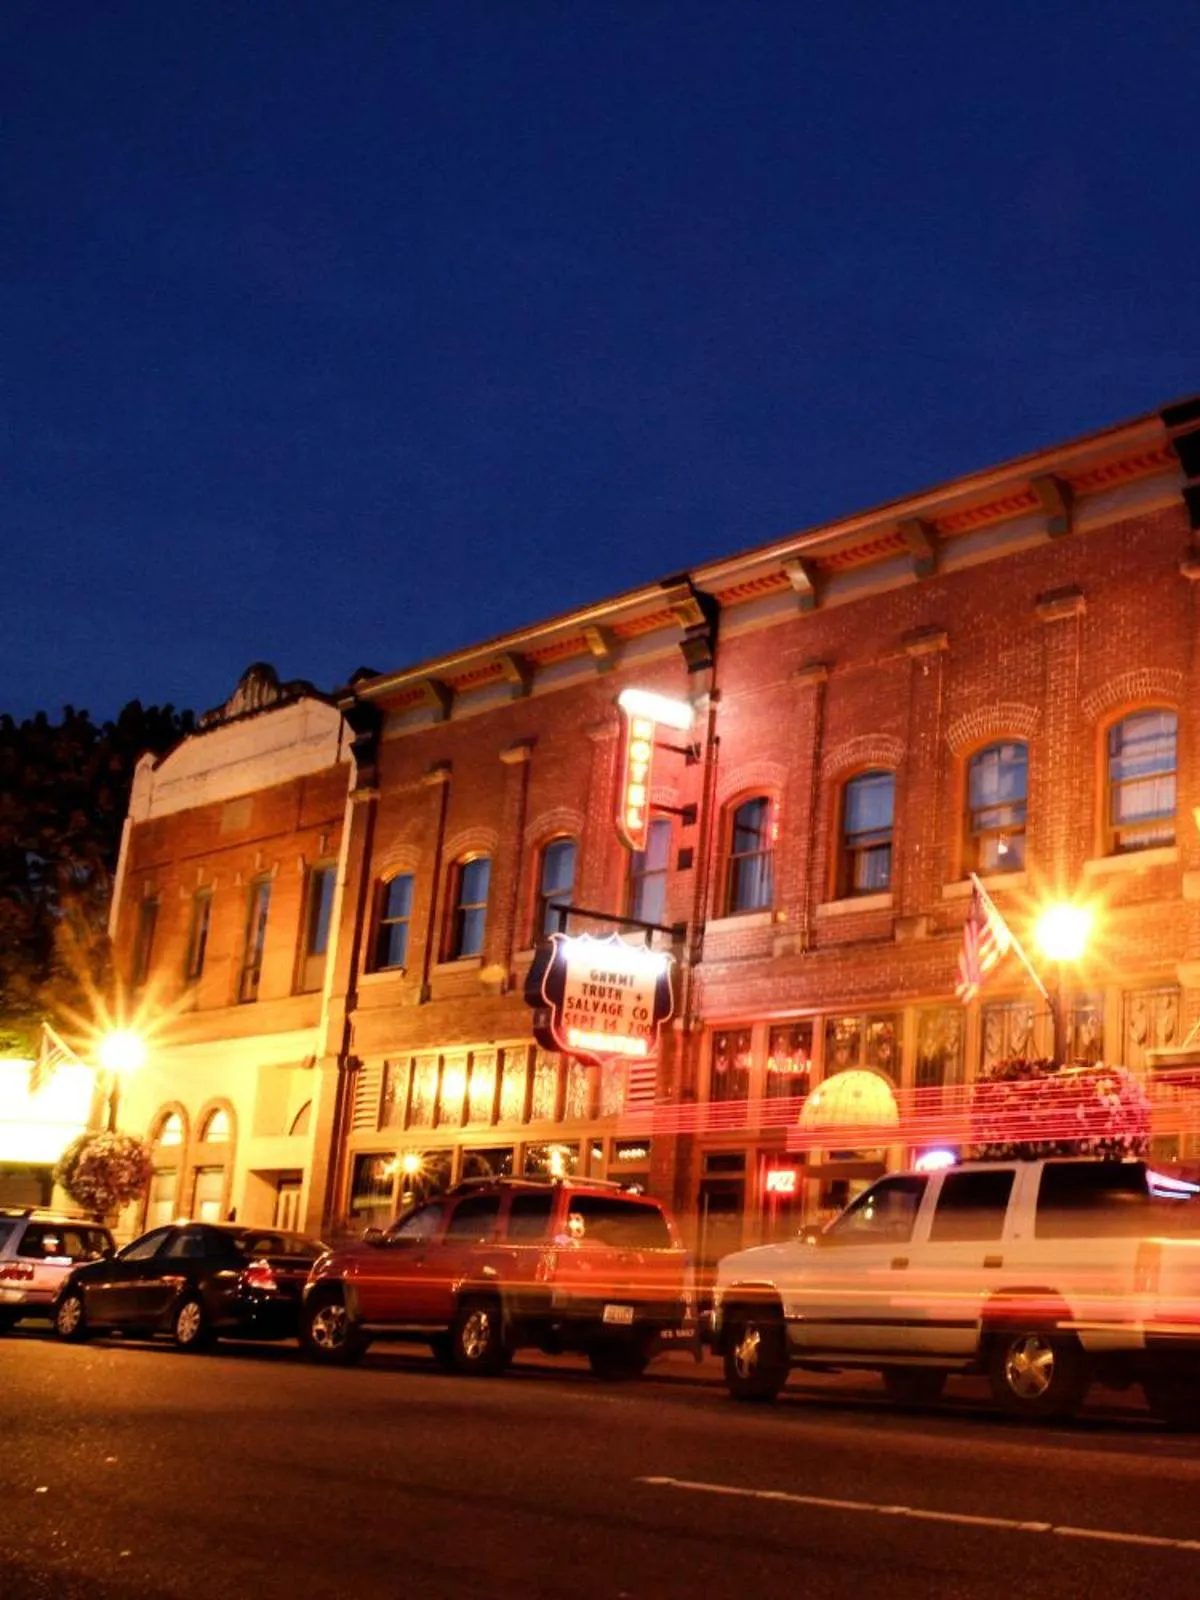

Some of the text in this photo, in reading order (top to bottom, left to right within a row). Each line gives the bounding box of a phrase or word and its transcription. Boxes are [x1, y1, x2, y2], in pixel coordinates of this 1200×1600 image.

[582, 983, 623, 1001] TRUTH
[566, 996, 648, 1020] SALVAGE CO
[564, 1012, 596, 1029] SEPT
